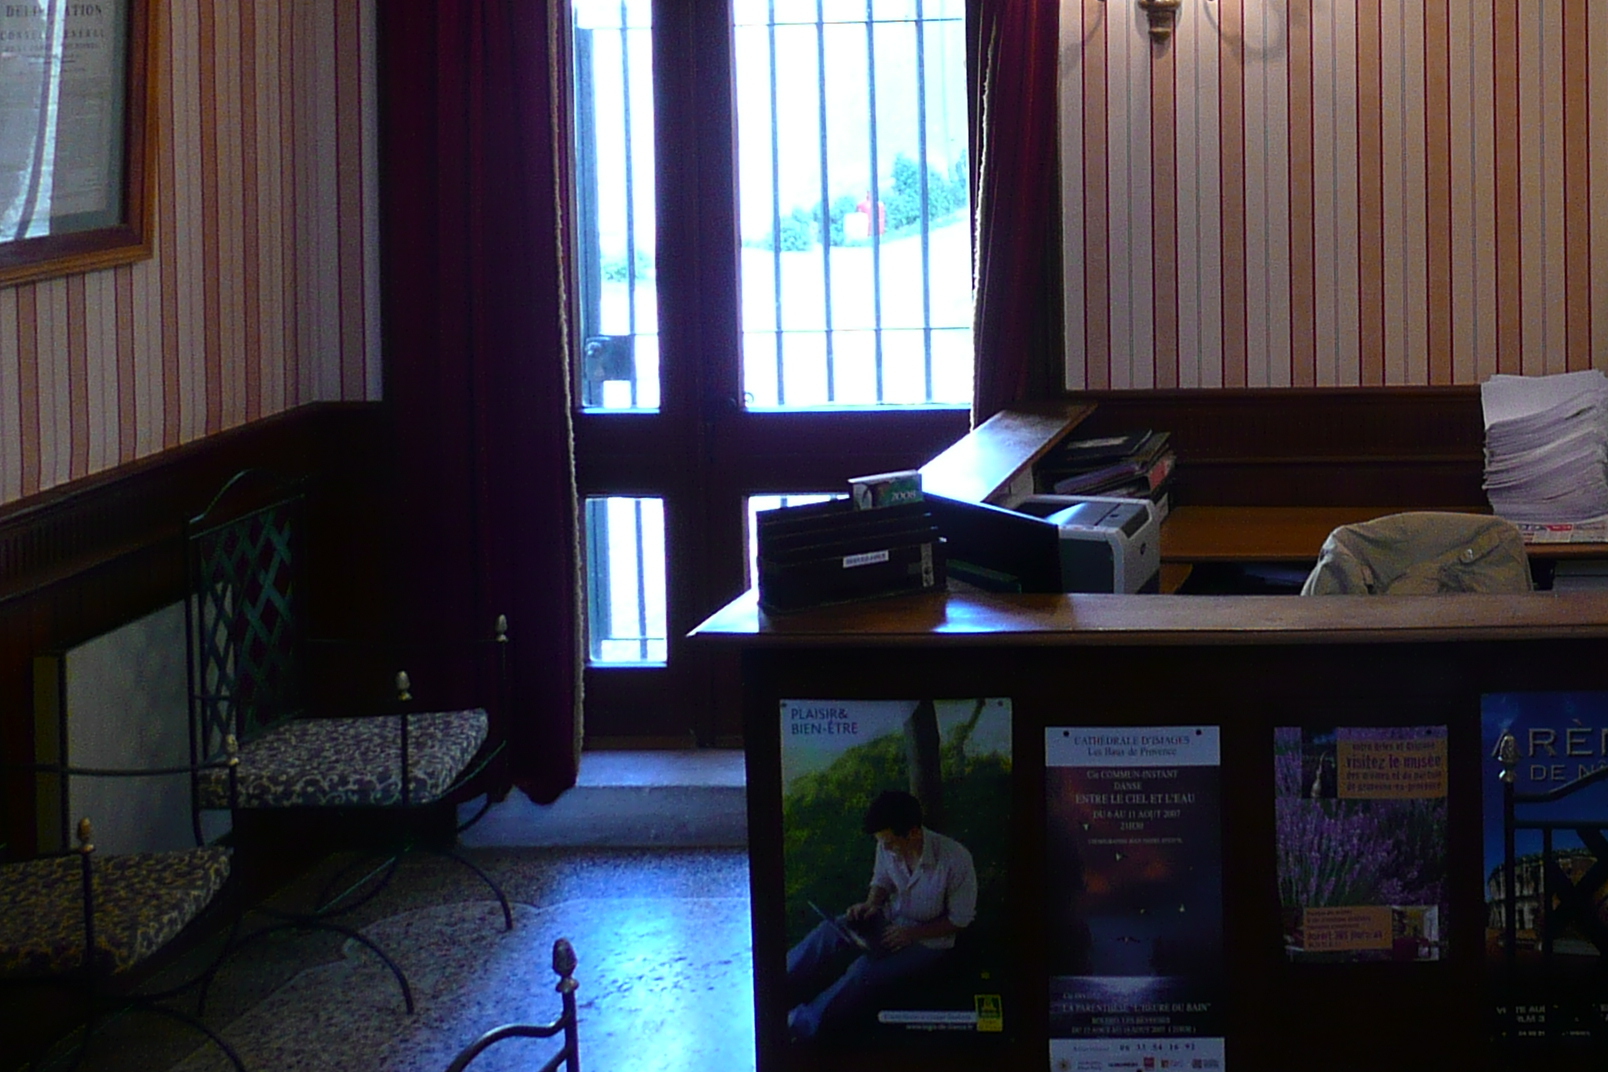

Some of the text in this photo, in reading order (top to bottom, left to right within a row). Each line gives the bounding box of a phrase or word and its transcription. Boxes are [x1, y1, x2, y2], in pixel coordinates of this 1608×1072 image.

[791, 708, 848, 720] PLAISIR&
[791, 721, 858, 735] BIEN-ÊTRE
[1141, 735, 1191, 745] D'IMAGES
[1128, 747, 1138, 756] de
[1140, 747, 1177, 756] Provence
[1346, 753, 1441, 770] visitez le musée
[1530, 764, 1566, 781] DE
[1113, 781, 1143, 791] DANSE
[1075, 793, 1196, 804] ENTRE LE CIEL ET L'EAU
